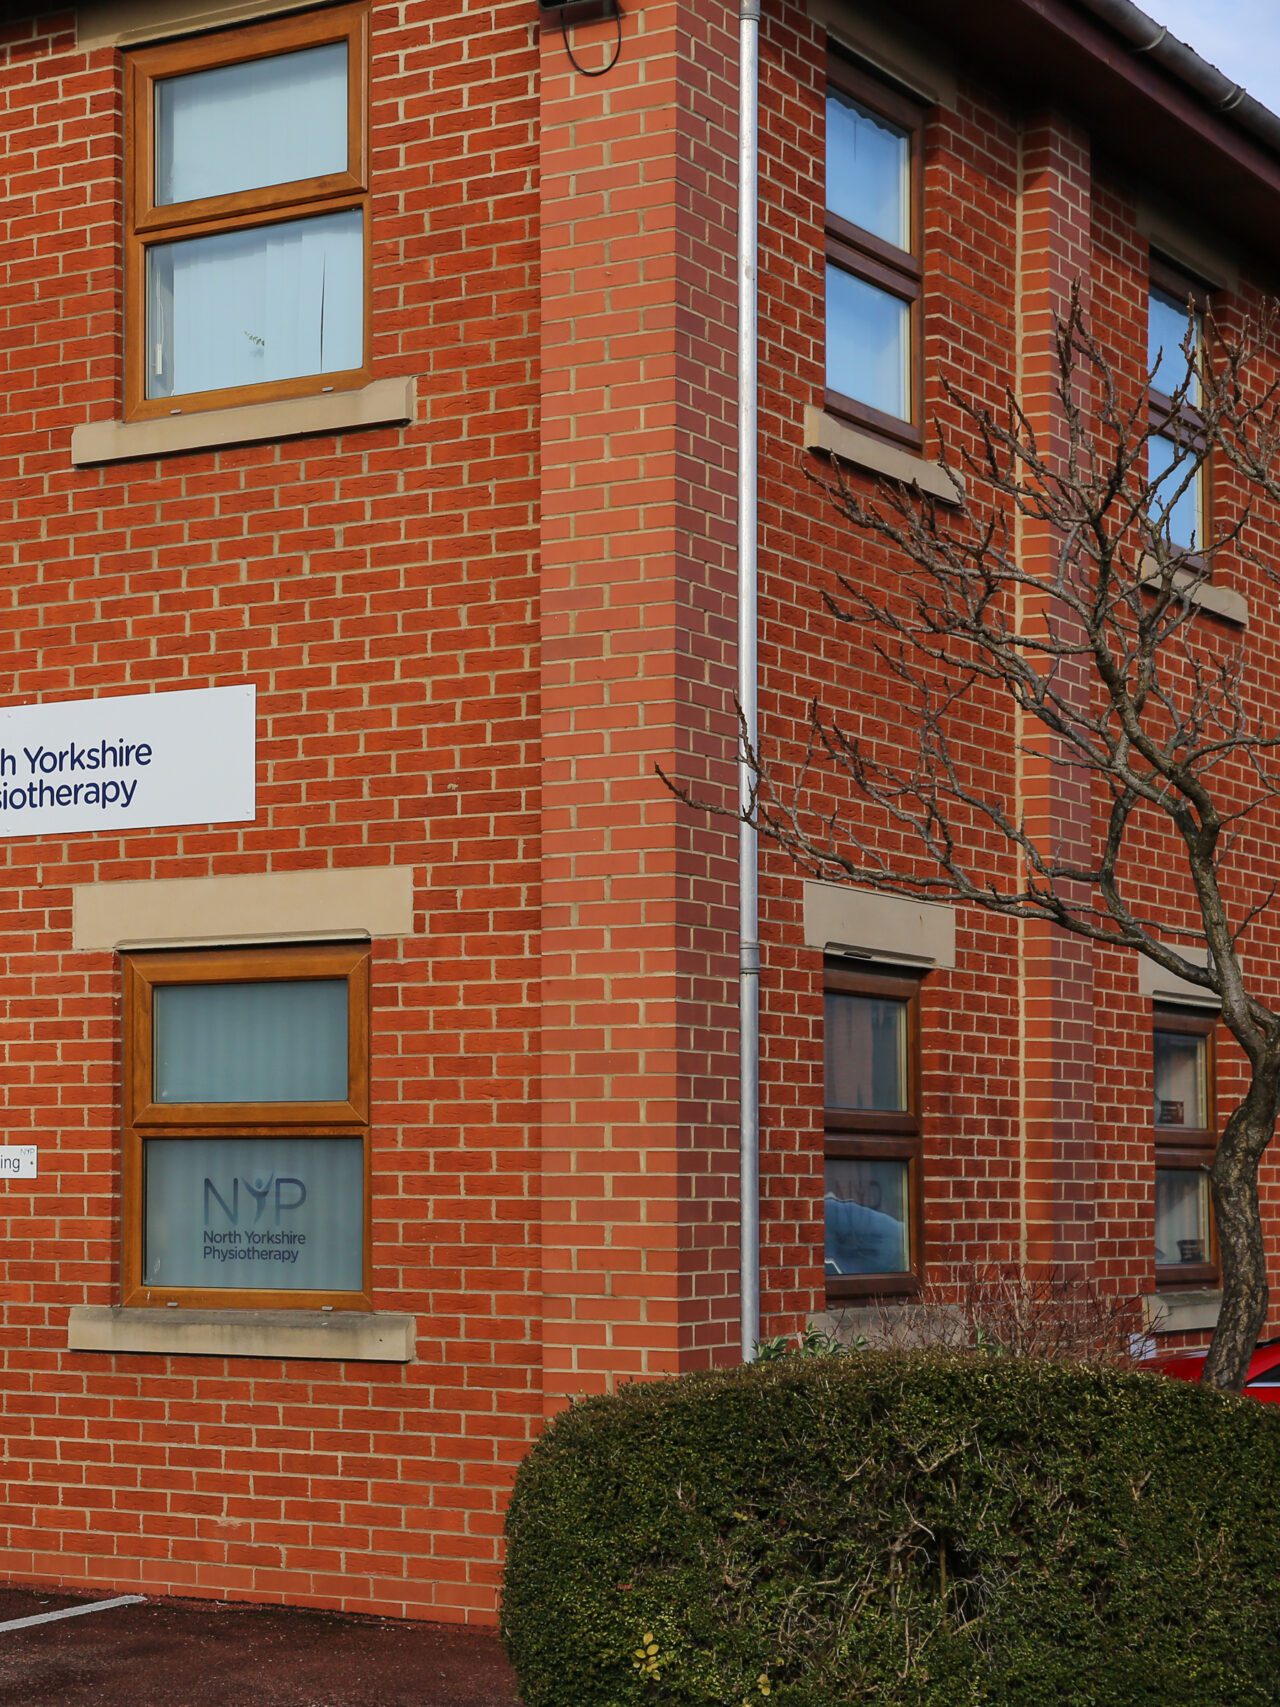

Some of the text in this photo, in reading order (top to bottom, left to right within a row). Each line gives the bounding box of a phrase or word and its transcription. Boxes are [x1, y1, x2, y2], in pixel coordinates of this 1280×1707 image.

[23, 738, 153, 774] Yorkshire
[203, 1169, 307, 1226] NYP
[203, 1230, 306, 1245] North Yorkshire
[203, 1246, 299, 1263] Physiotherapy
